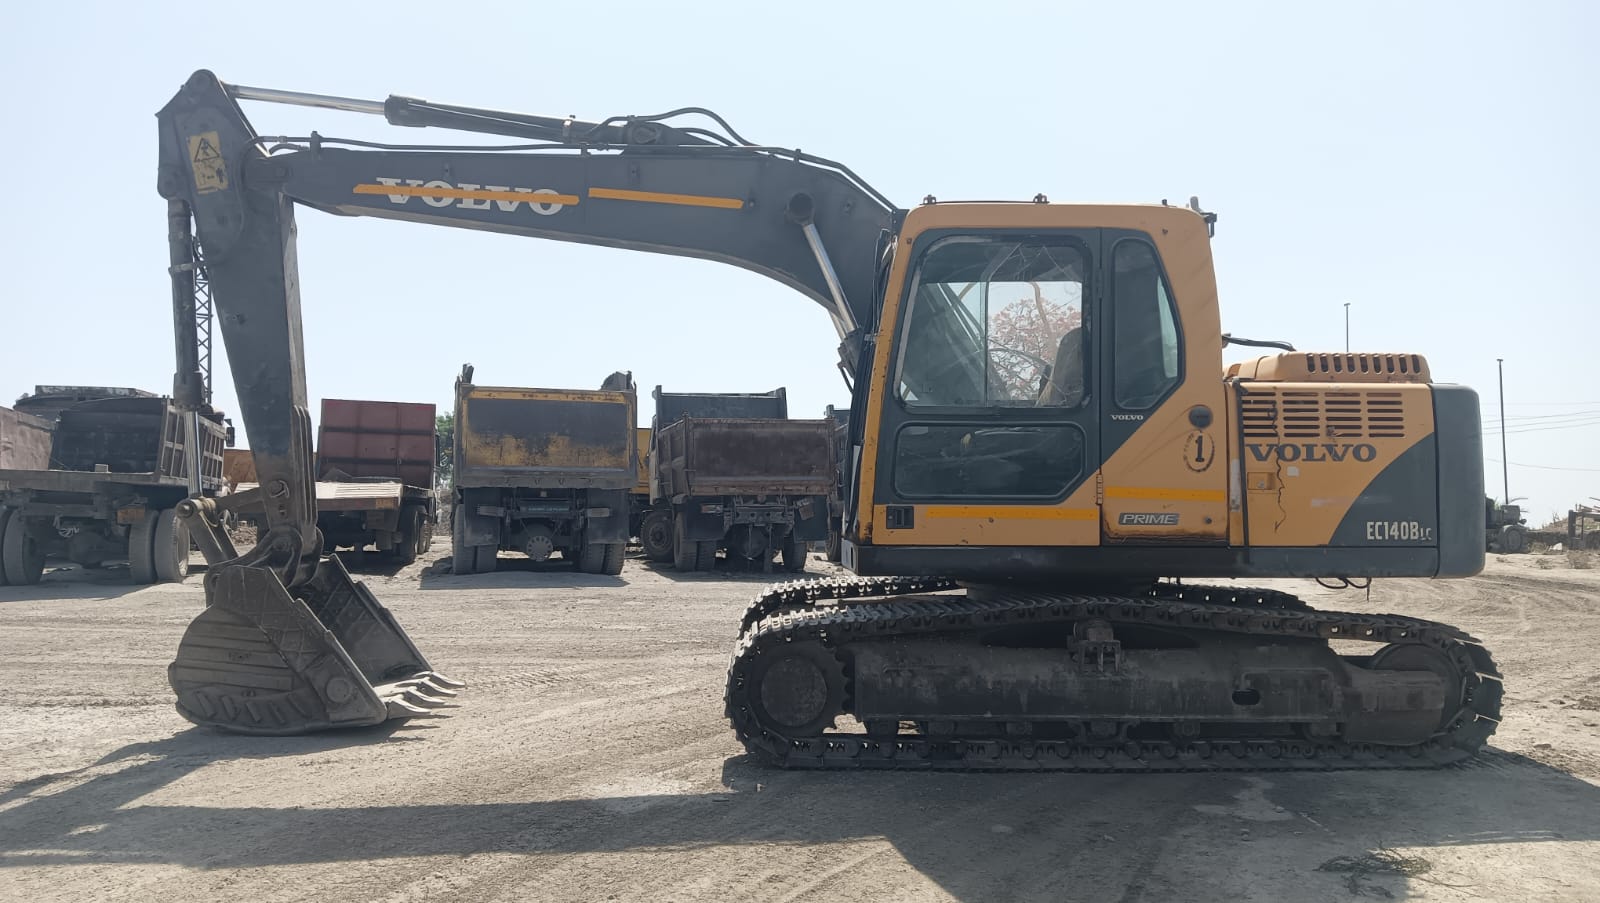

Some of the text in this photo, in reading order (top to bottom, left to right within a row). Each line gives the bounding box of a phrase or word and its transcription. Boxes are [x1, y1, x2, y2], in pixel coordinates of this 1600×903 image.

[376, 177, 563, 215] VOLVO
[1195, 435, 1204, 462] 1
[1245, 443, 1377, 462] VOLVO
[1121, 514, 1177, 524] PRIME
